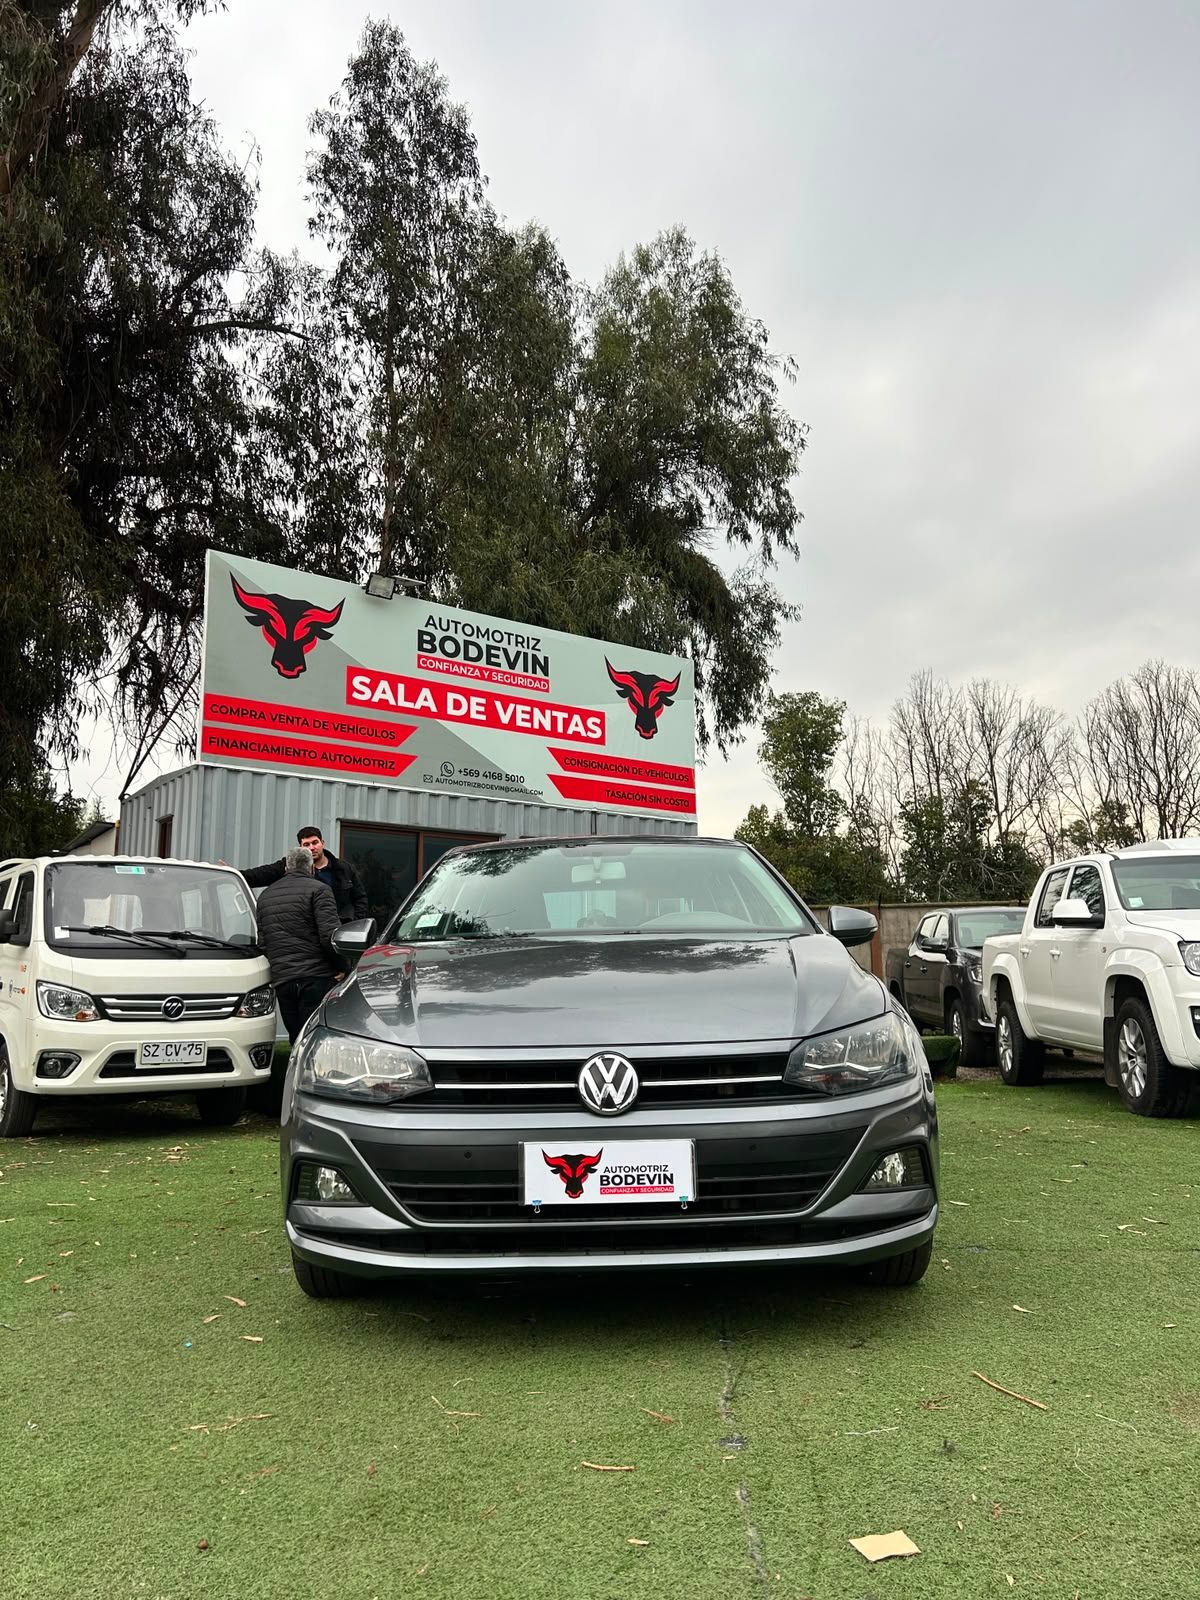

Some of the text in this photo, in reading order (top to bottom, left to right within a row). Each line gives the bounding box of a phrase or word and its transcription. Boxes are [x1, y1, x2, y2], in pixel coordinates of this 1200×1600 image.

[424, 615, 541, 652] AUTOMOTRIZ
[417, 629, 549, 677] BODEVIN
[420, 657, 549, 690] CONFIANZA Y SEGURIDAD
[209, 703, 396, 740] COMPRA VENTA DE VEHÍCULOS
[352, 675, 603, 739] SALA DE VENTAS
[208, 736, 396, 770] FINANCIAMIENTO AUTOMOTRIZ
[458, 767, 525, 784] +569 4168 5010
[563, 757, 689, 783] CONSIGNACIÓN DE VEHÍCULOS
[435, 777, 544, 796] AUTOMOTRIZBODEVIN@GMAIL.COM
[605, 789, 690, 807] TASACIÓN SIN COSTO
[600, 1173, 674, 1186] BODEVIN
[603, 1165, 669, 1173] AUTOMOTRIZ
